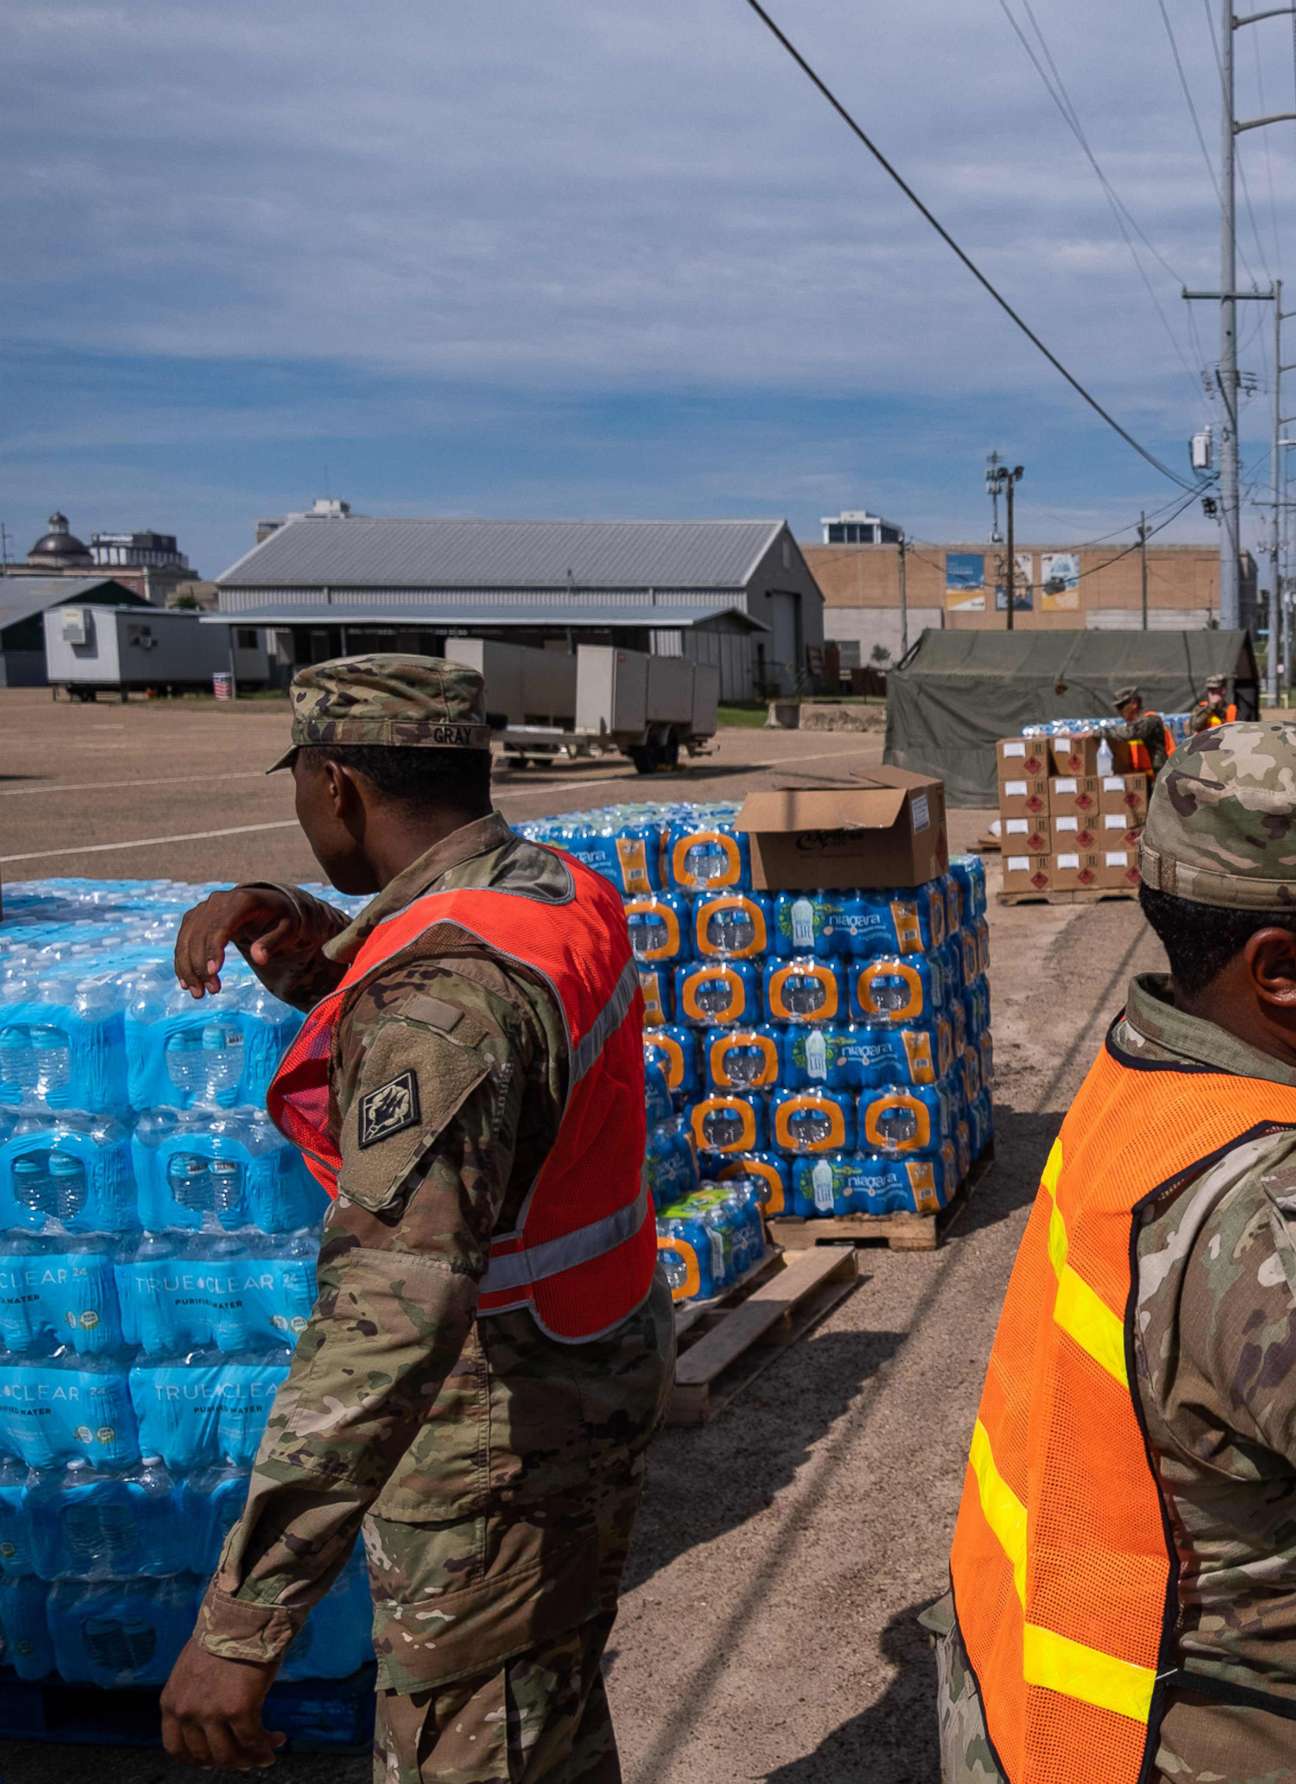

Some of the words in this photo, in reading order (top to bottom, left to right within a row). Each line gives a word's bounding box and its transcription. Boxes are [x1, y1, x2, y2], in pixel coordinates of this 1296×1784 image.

[433, 727, 473, 744] GRAY
[828, 913, 882, 932] niagara
[136, 1275, 194, 1293] TRUE
[206, 1273, 274, 1294] CLEAR
[222, 1383, 278, 1400] CLEA
